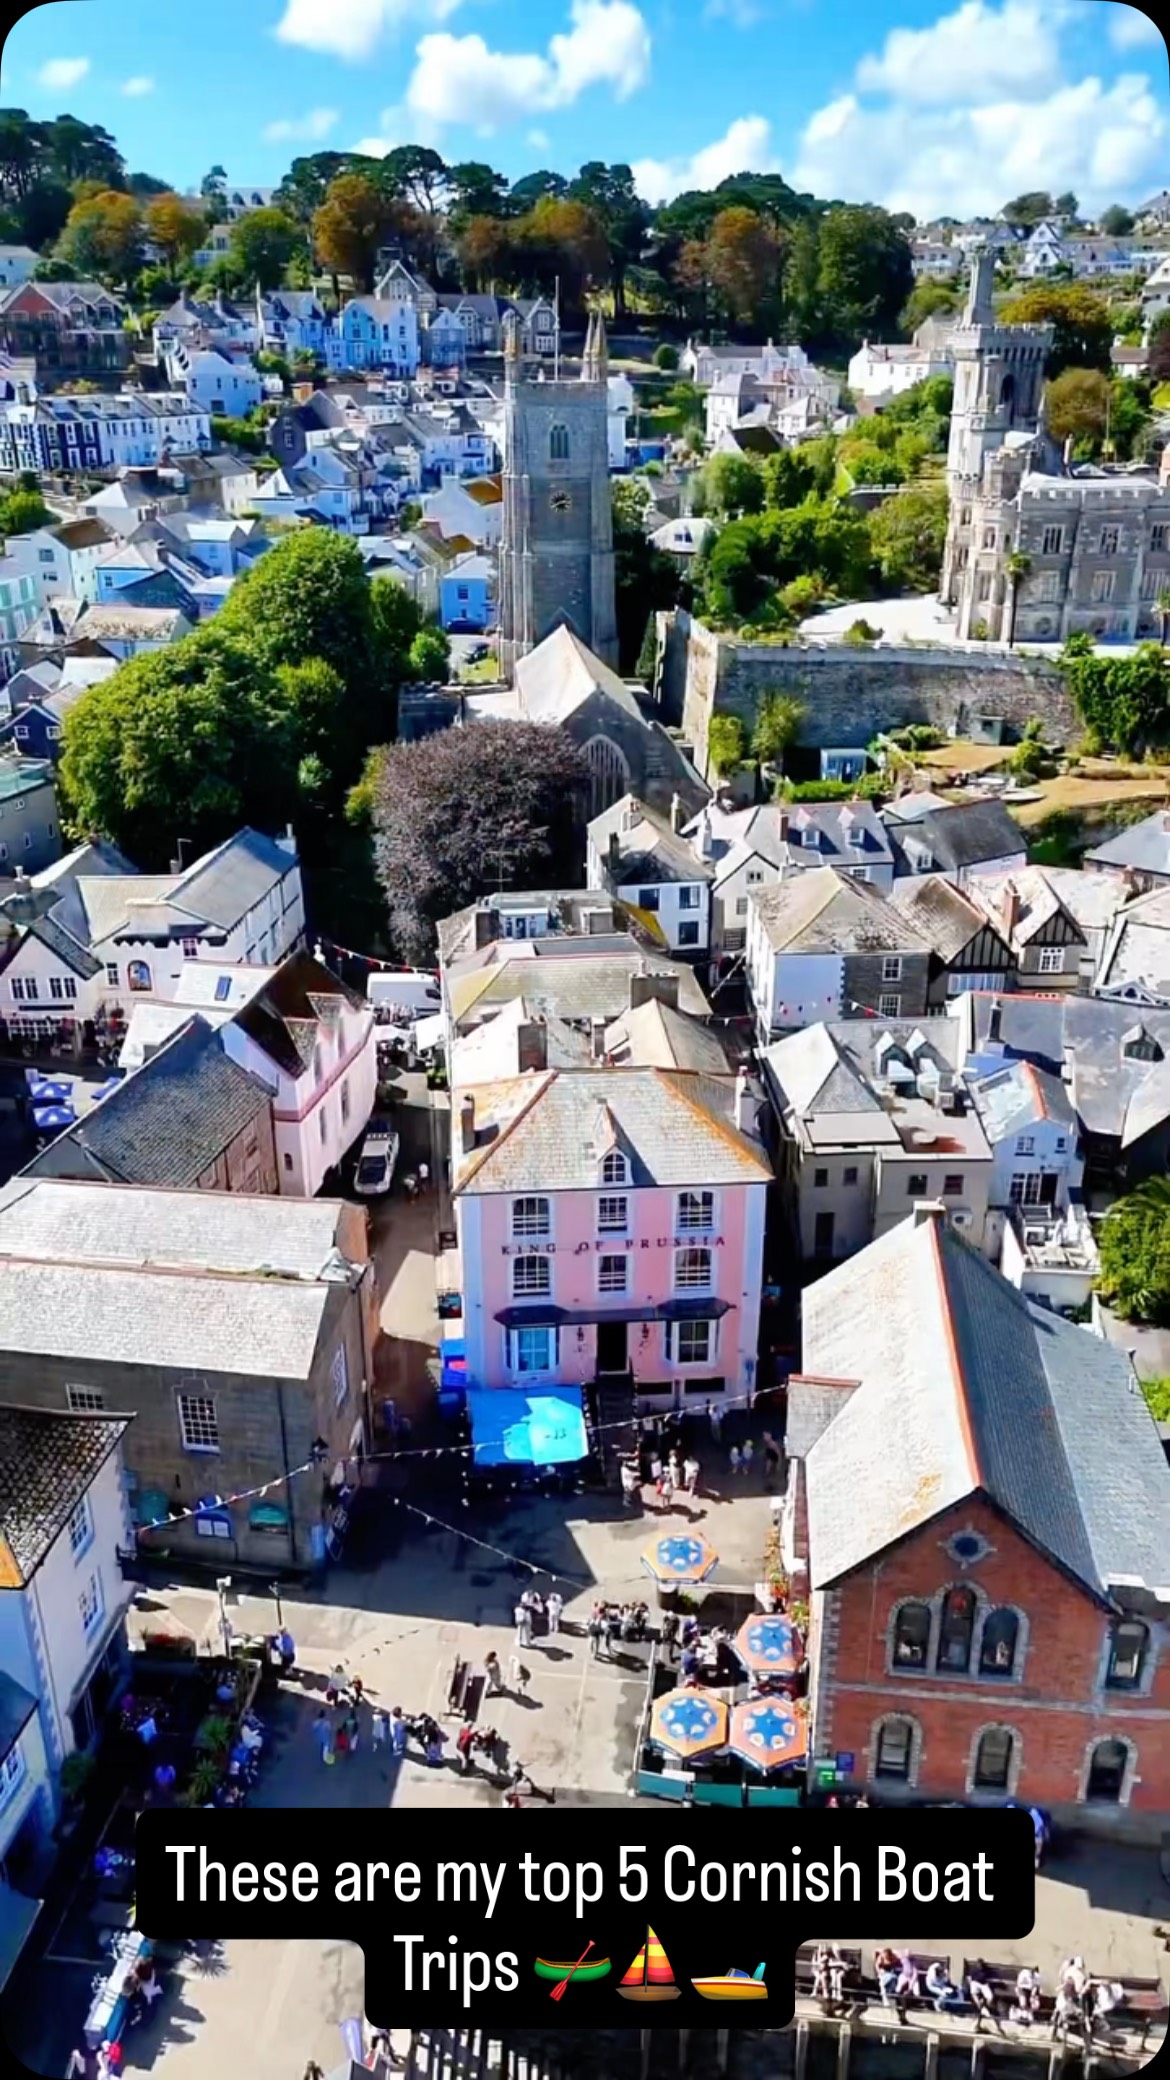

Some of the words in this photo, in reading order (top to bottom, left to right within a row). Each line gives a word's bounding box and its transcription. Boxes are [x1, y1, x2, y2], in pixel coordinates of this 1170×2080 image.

[501, 1243, 557, 1255] KING
[578, 1241, 605, 1252] OF
[625, 1236, 726, 1250] PRUSSIA
